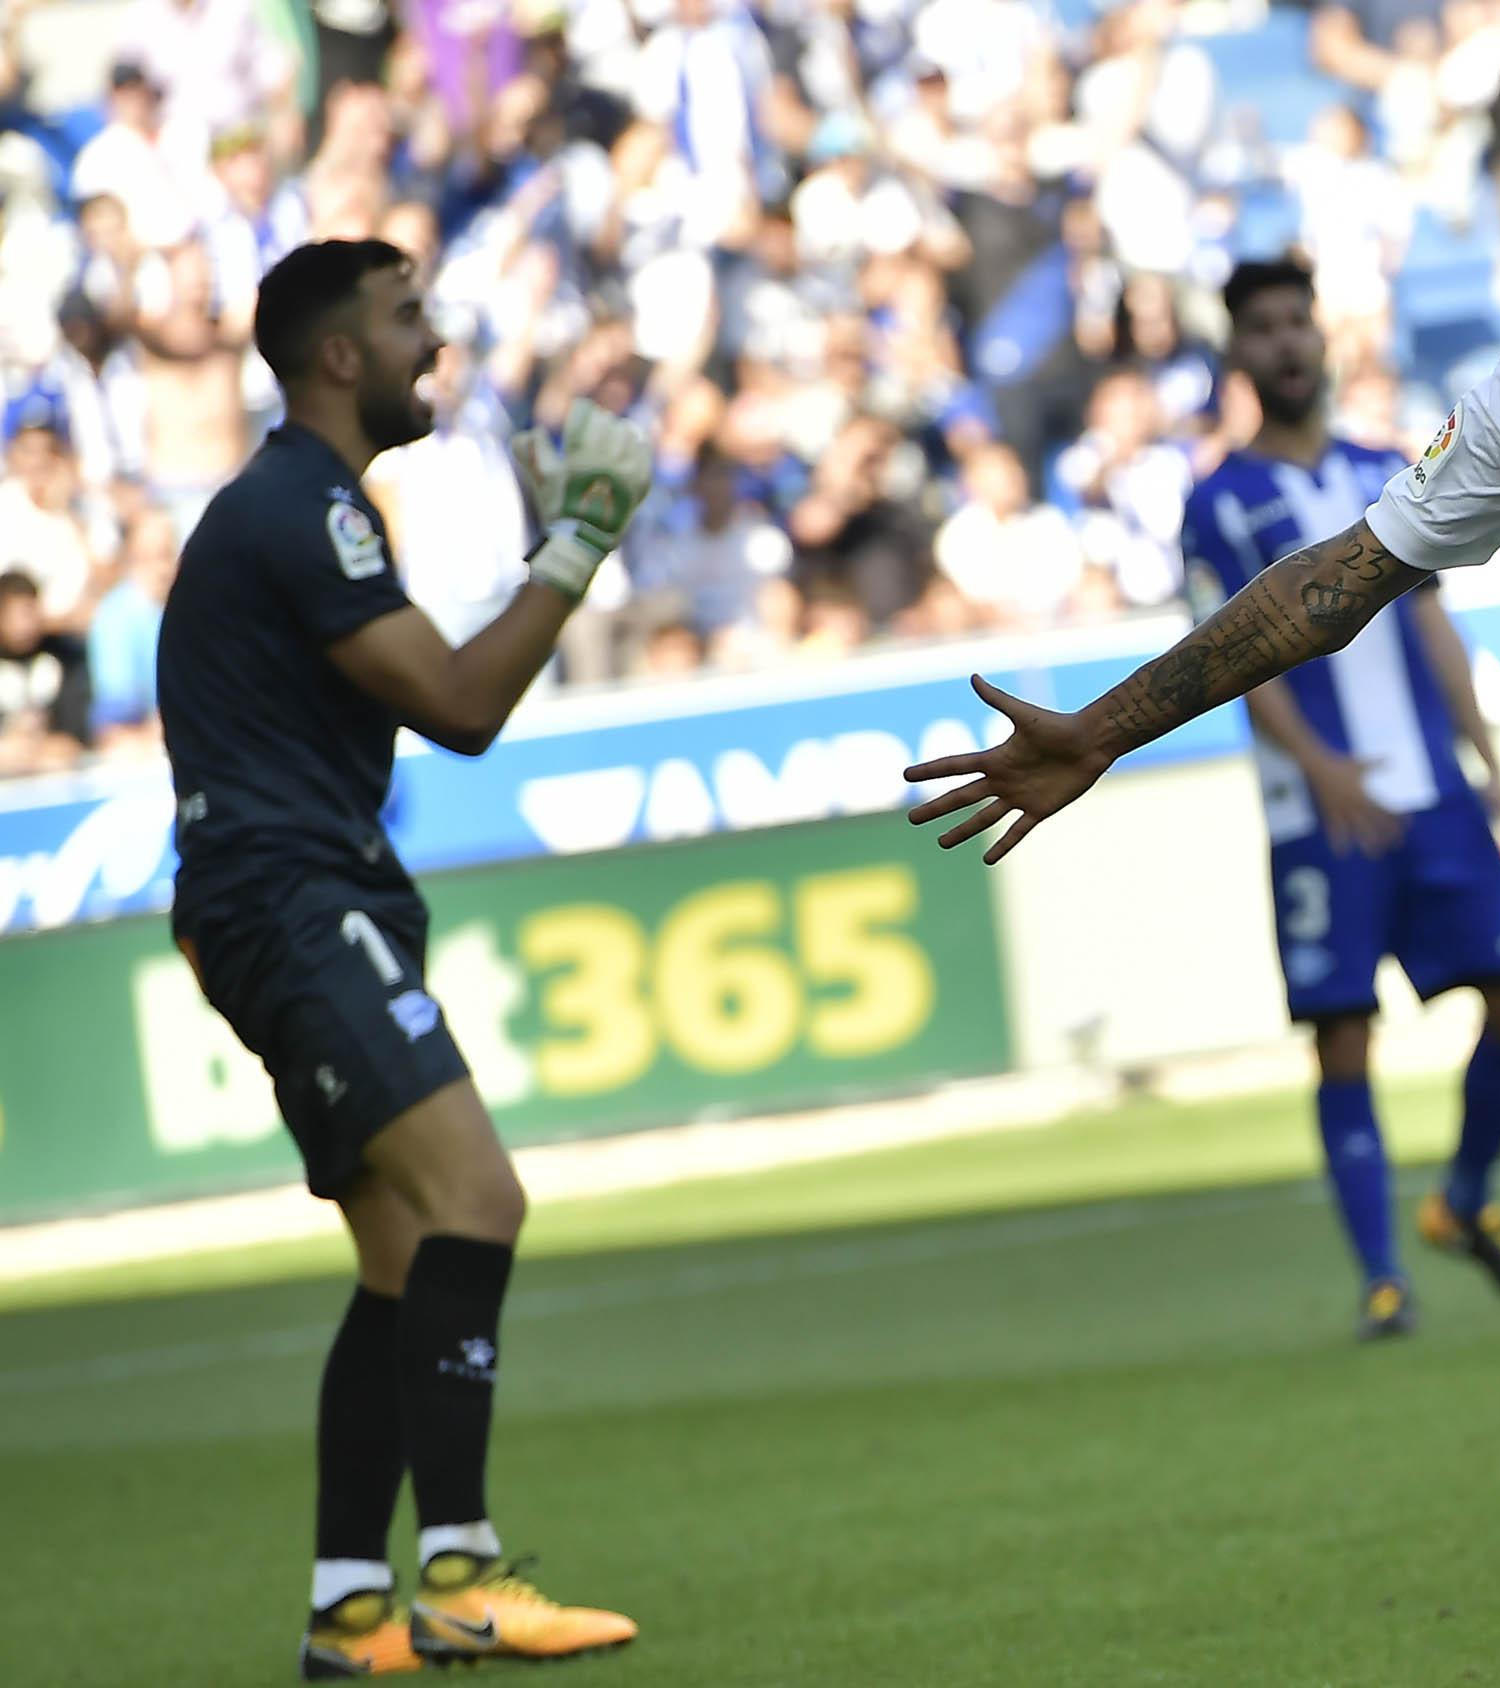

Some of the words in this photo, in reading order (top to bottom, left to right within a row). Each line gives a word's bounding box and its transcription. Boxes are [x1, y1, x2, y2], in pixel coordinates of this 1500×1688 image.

[1283, 868, 1331, 942] 3
[340, 908, 402, 985] 1
[132, 864, 937, 1157] bt365
